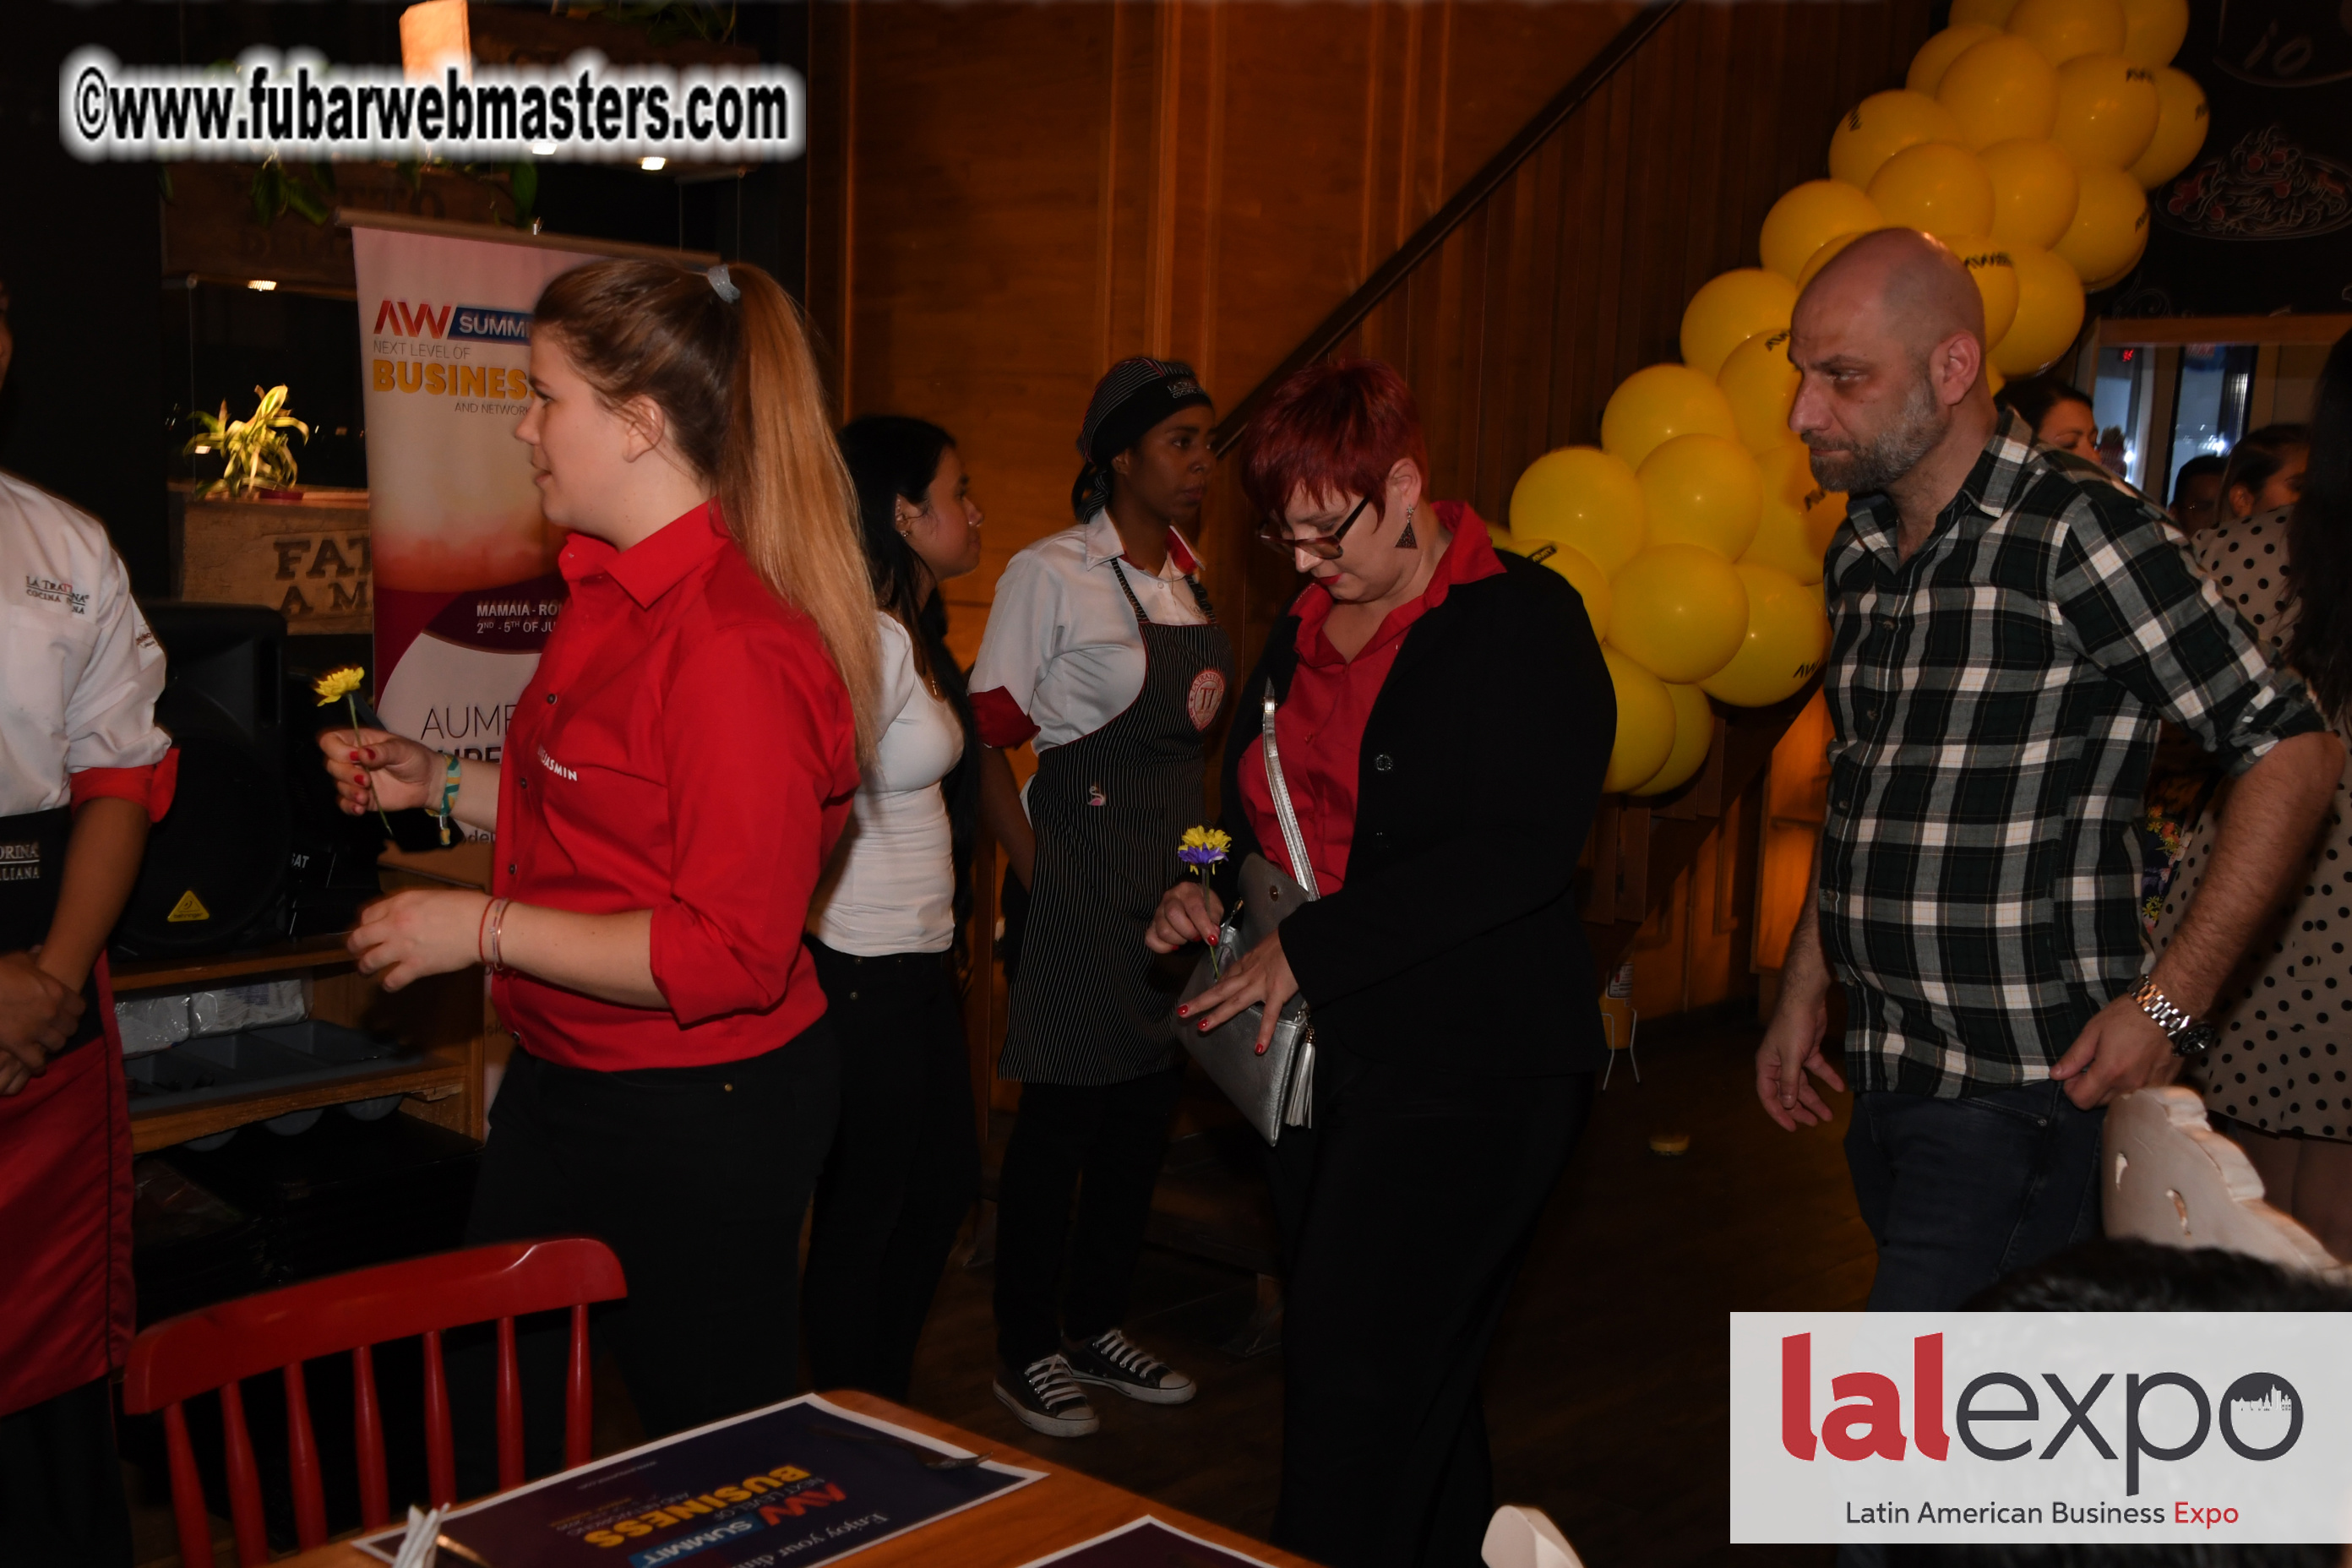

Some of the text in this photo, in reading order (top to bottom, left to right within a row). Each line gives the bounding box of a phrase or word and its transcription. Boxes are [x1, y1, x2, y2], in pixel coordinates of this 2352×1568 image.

[373, 301, 451, 340] AW
[373, 340, 471, 360] NEXT LEVEL OF
[373, 358, 536, 400] BUSINES
[455, 402, 479, 414] AND
[476, 603, 531, 618] MAMAIA
[522, 621, 539, 634] OF
[583, 1464, 812, 1549] BUSINESS
[825, 1512, 890, 1540] Enjoy
[641, 1519, 753, 1565] SUMMIT
[777, 1532, 826, 1559] your
